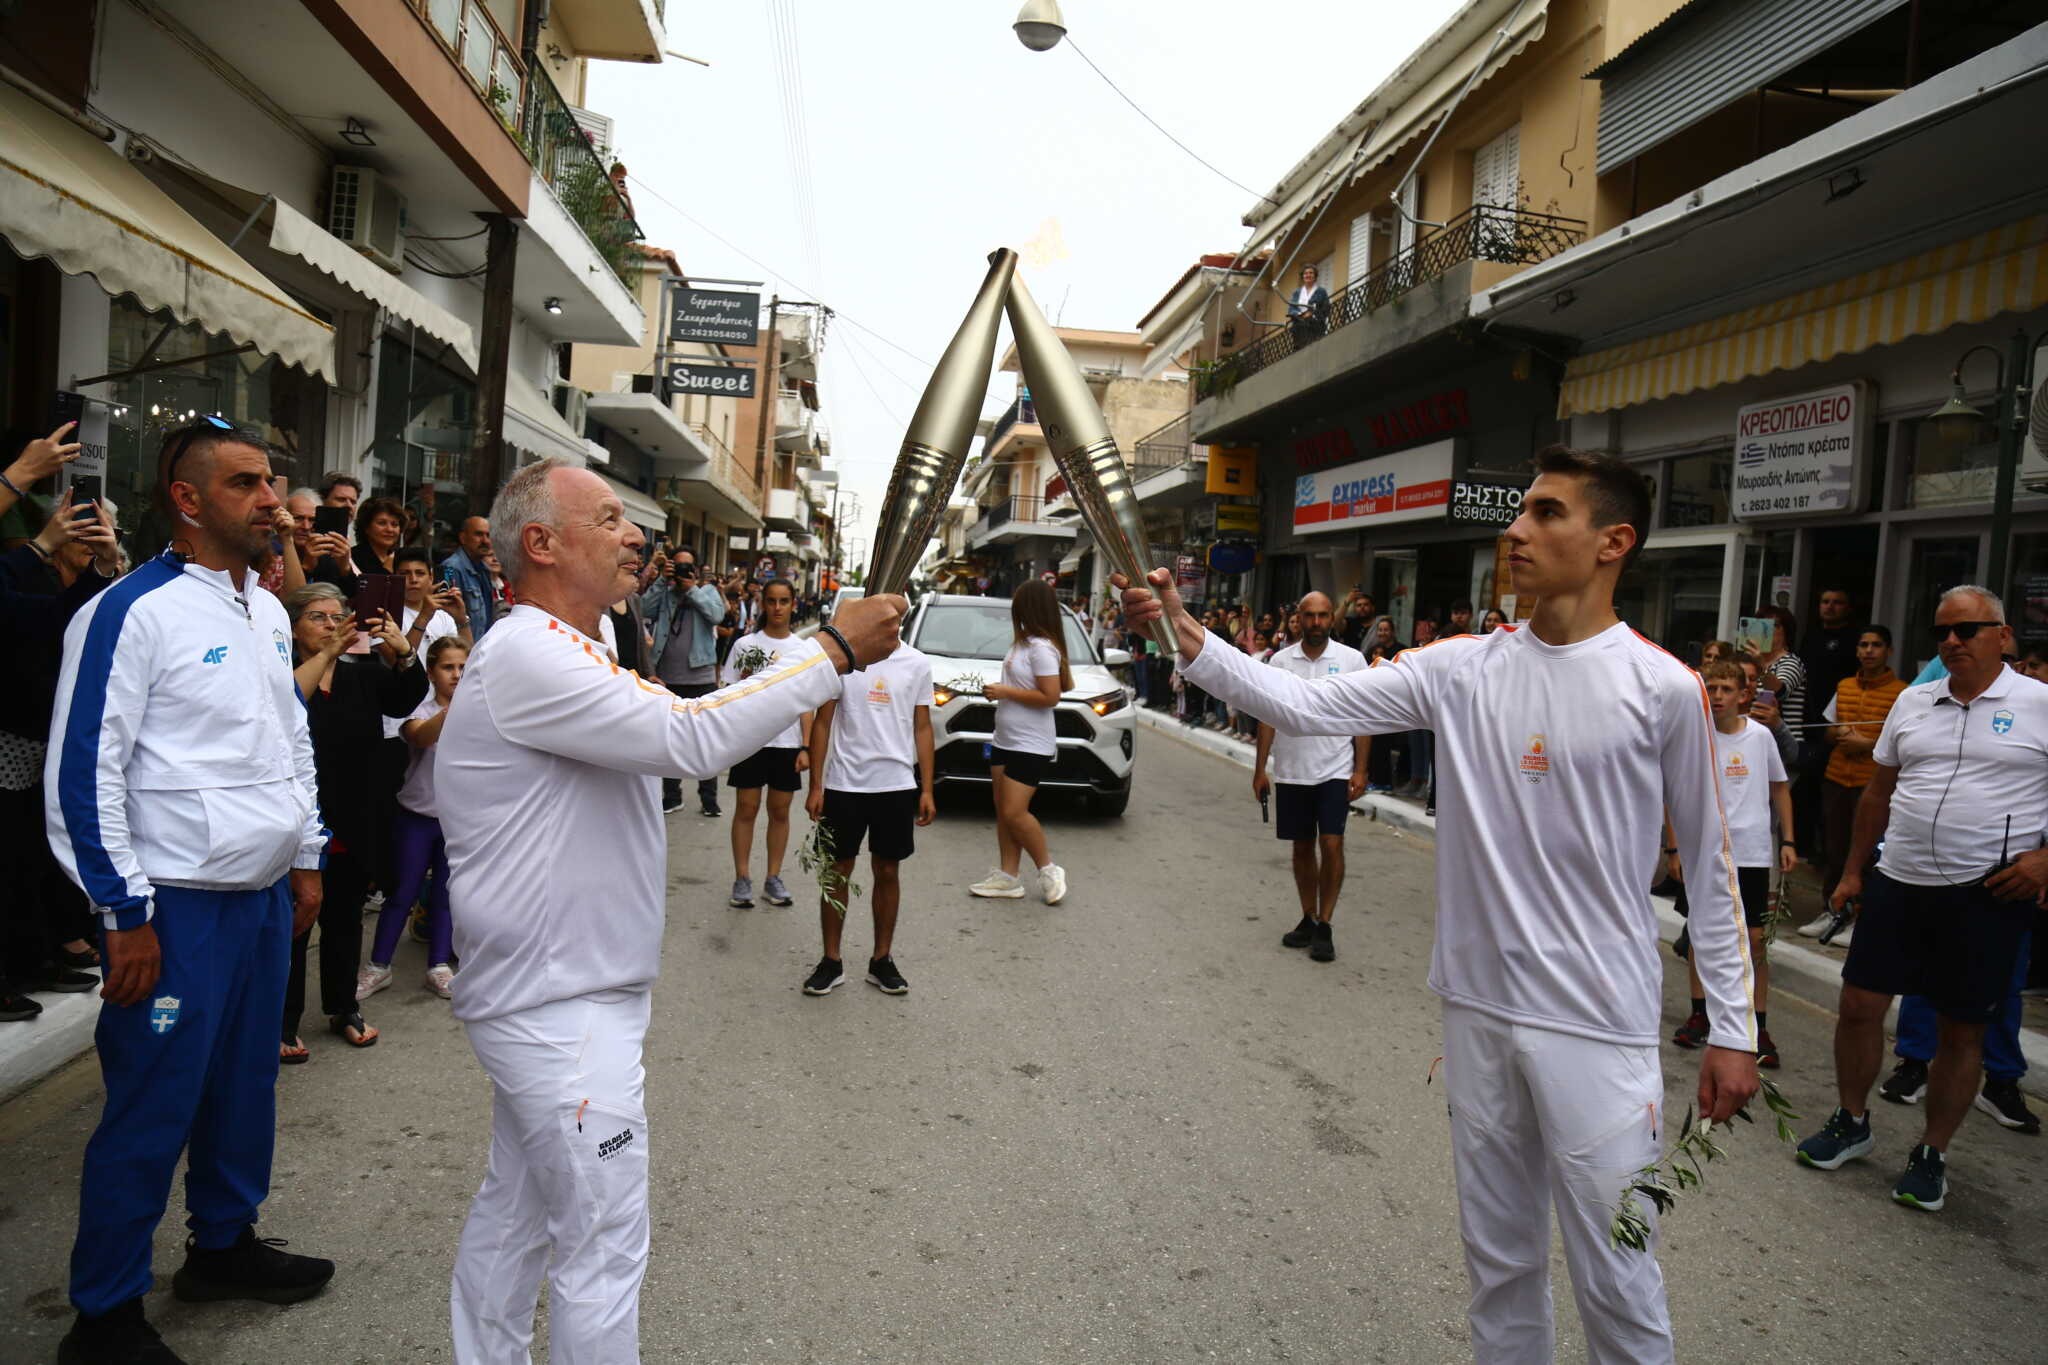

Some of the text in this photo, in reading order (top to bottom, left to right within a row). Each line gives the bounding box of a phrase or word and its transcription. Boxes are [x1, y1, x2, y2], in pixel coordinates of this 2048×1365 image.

[672, 368, 750, 392] Sweet
[1740, 395, 1850, 437] ΚΡΕΟΠΩΛΕΙΟ
[1768, 437, 1850, 459] Ντόπια κρέατα
[1785, 469, 1820, 485] Αντώνης
[1332, 472, 1395, 516] express
[1354, 501, 1377, 516] market
[1749, 499, 1771, 511] 2623
[1773, 497, 1790, 509] 402
[1793, 496, 1810, 507] 187
[202, 645, 228, 664] 4F
[599, 1134, 622, 1150] RELAIS
[598, 1149, 608, 1158] LA
